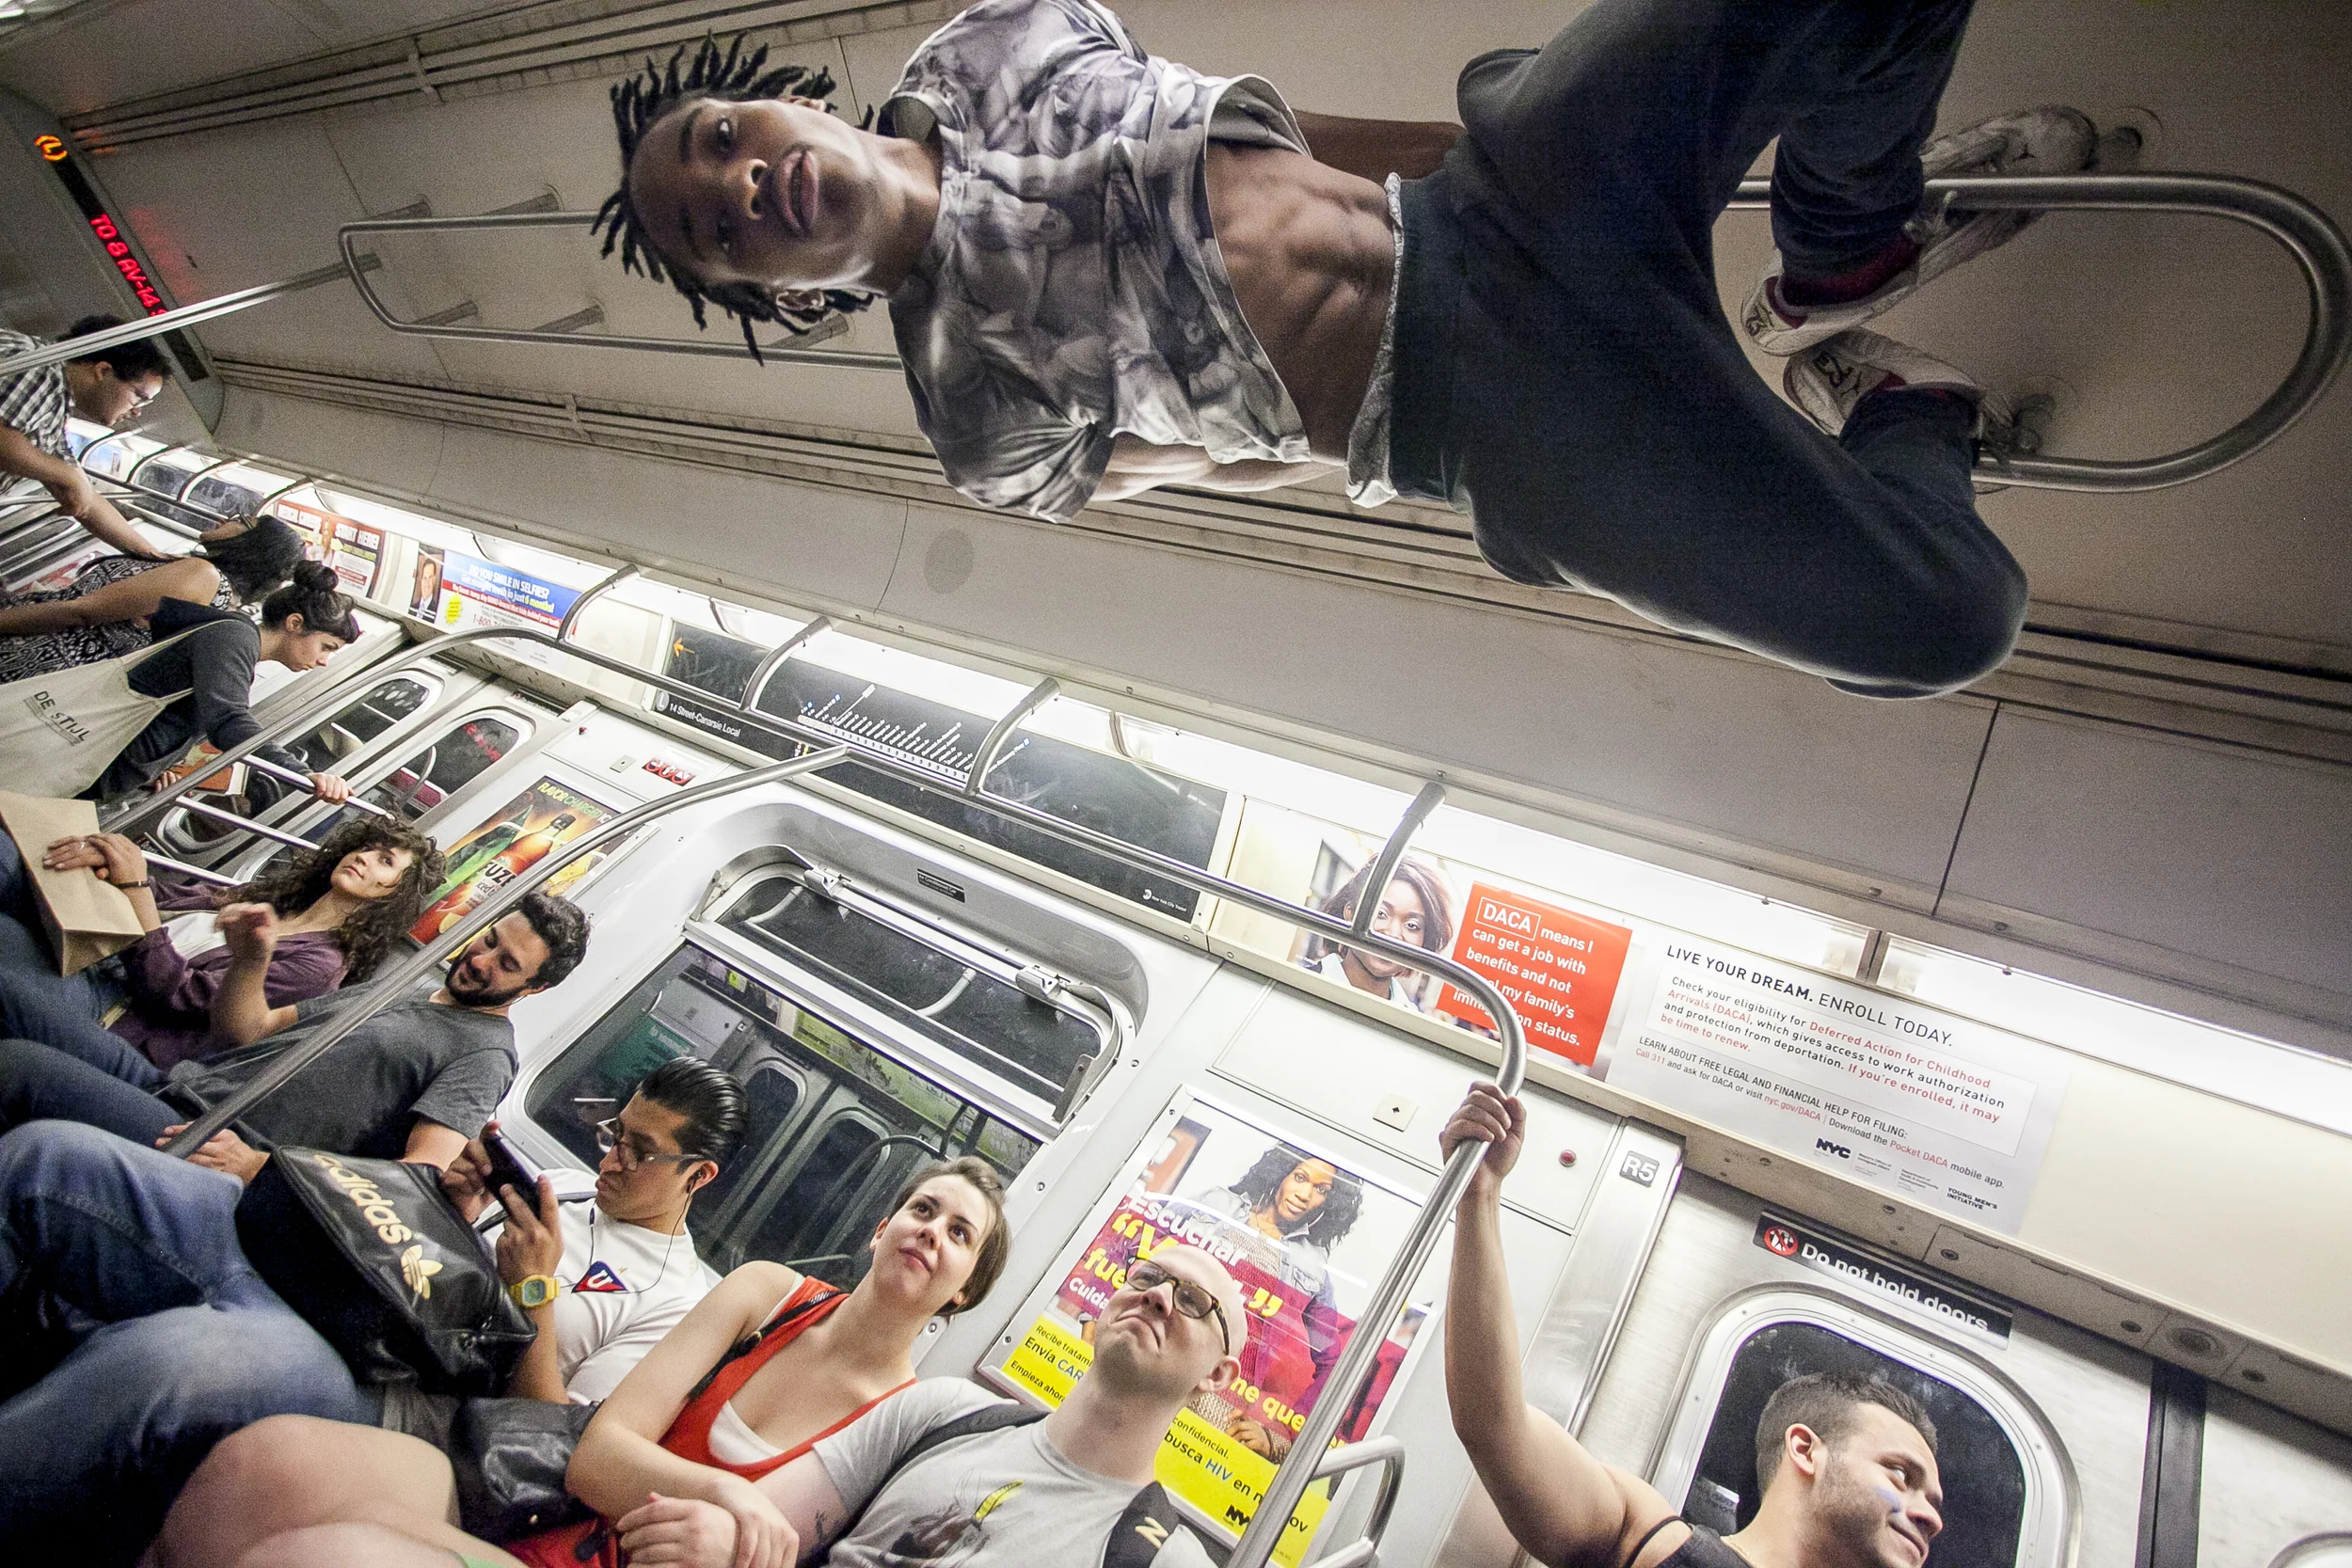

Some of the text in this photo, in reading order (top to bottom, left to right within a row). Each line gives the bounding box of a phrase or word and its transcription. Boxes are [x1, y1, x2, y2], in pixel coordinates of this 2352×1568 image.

[90, 214, 118, 240] TO
[106, 242, 129, 258] 8
[117, 258, 160, 308] AV-14
[513, 578, 519, 590] IN
[520, 581, 549, 599] SELFIES?
[525, 595, 529, 604] 6
[34, 690, 90, 742] DE STIJL
[670, 703, 677, 713] 14
[723, 722, 741, 737] Local
[537, 781, 566, 803] FLAVOR
[563, 796, 603, 818] CHARGED
[1483, 903, 1594, 953] DACA means I
[1466, 946, 1572, 994] benefits and not
[1472, 929, 1586, 975] can get a job with
[1502, 985, 1575, 1020] my family's
[1667, 945, 1953, 1046] LIVE YOUR DREAM. ENROLL TODAY.
[1534, 1022, 1581, 1046] status.
[1661, 1014, 1751, 1052] be time to renew.
[1667, 990, 2005, 1108] Arrivals (DACA), which gives access to work authorization
[1672, 976, 1991, 1088] Check your eligibility for Deferred Action for Childhood
[1664, 1002, 2000, 1124] and protection from deportation. If you're enrolled, it may
[1639, 1037, 1908, 1139] LEARN ABOUT FREE LEGAL AND FINANCIAL HELP FOR FILING:
[1635, 1048, 2005, 1189] Call 311 and ask for DACA or visit nyc.gov/DACA Download the Pocket DACA mobile app.
[1816, 1138, 1851, 1159] NYC
[1622, 1155, 1657, 1181] R5
[314, 1154, 412, 1245] adidas
[1947, 1187, 1997, 1210] YOUNG MEN'S
[1947, 1193, 1983, 1210] INITIATIVE
[1127, 1196, 1248, 1267] Escuchar
[587, 1269, 613, 1289] U
[1801, 1243, 1988, 1333] Do not hold doors
[1025, 1337, 1056, 1364] Envía
[1036, 1325, 1062, 1347] Recibe
[1010, 1360, 1044, 1387] Empieza
[1172, 1417, 1229, 1459] confidencial.
[1164, 1430, 1251, 1496] busca HIV en
[1225, 1504, 1250, 1526] NY
